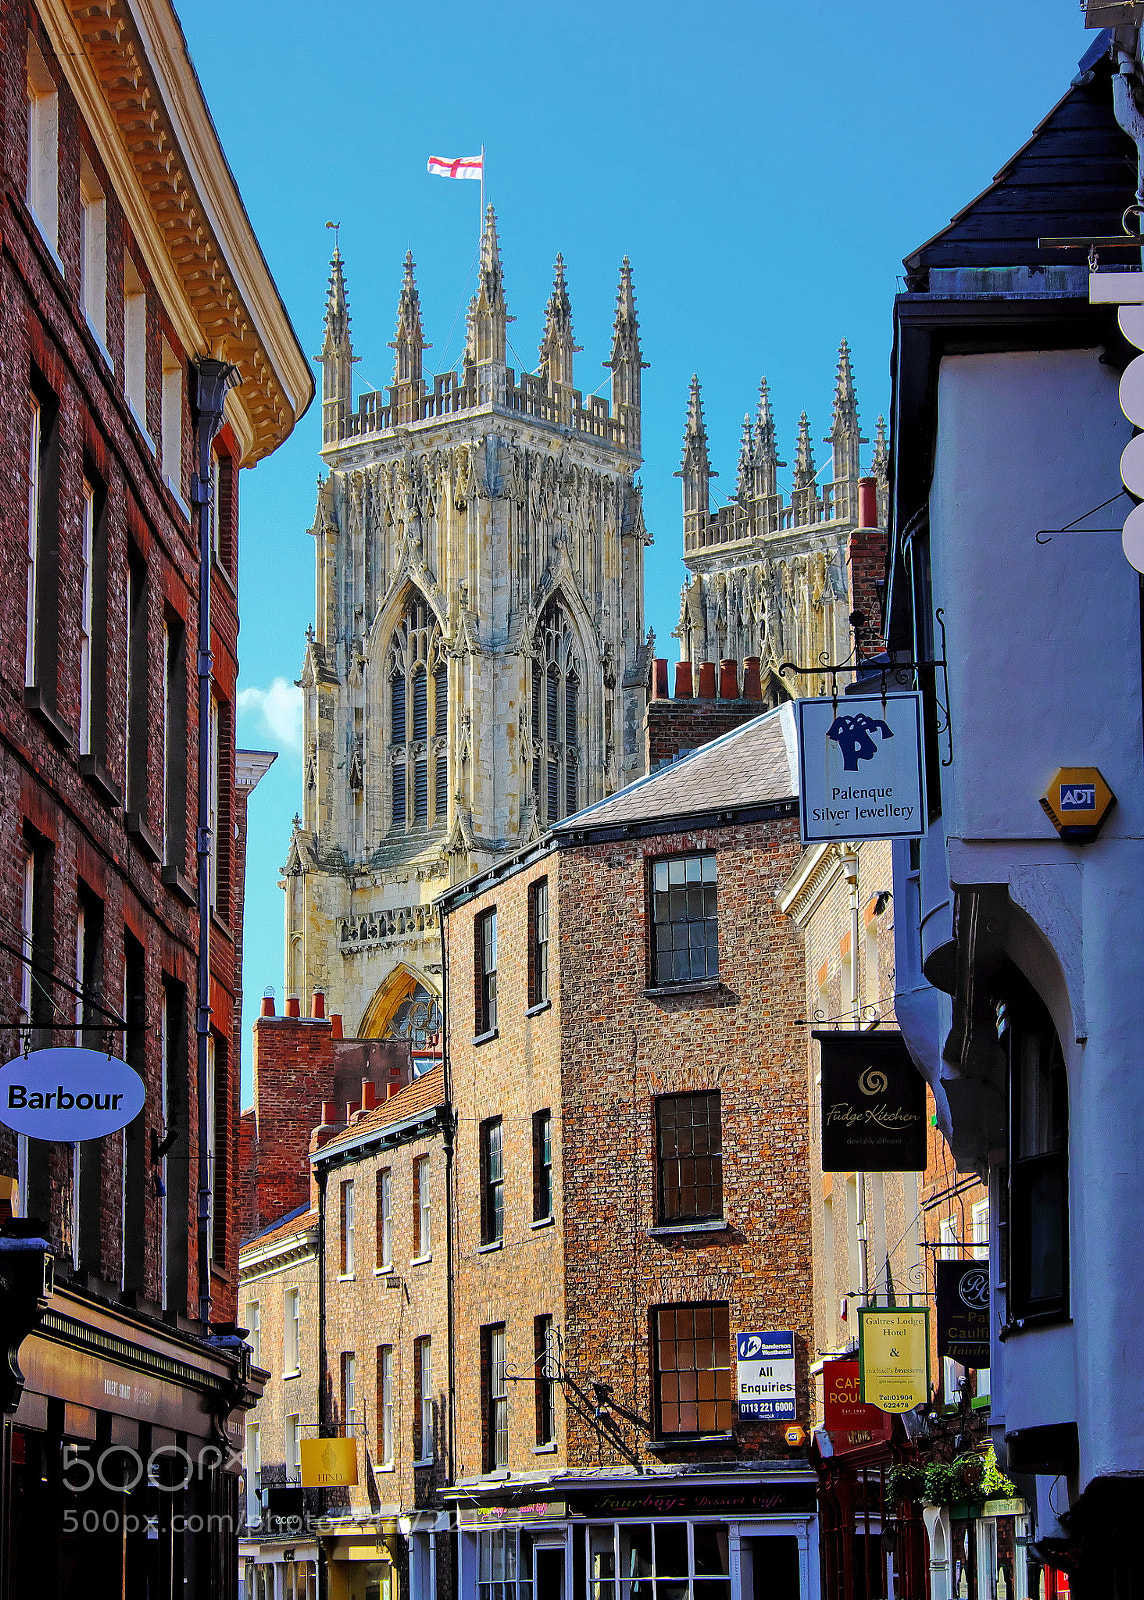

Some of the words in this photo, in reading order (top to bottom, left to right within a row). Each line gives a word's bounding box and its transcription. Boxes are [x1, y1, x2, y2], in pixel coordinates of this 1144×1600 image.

[831, 786, 893, 802] Palenque
[1061, 789, 1095, 804] ADT
[812, 807, 850, 821] Silver
[855, 804, 914, 821] Jewellery
[7, 1084, 124, 1110] Barbour
[826, 1102, 865, 1127] Fudge
[865, 1103, 921, 1130] Kitchen
[865, 1317, 895, 1325] Galtres
[897, 1317, 923, 1326] Lodge
[967, 1312, 990, 1323] Pa
[889, 1347, 900, 1358] &
[758, 1366, 773, 1377] All
[894, 1366, 924, 1374] brasserie
[741, 1381, 793, 1395] Enquiries
[829, 1392, 861, 1404] ROU
[741, 1403, 759, 1413] 0113
[759, 1402, 773, 1412] 221
[775, 1402, 793, 1412] 6000
[318, 1473, 343, 1482] HIND
[275, 1516, 299, 1525] ecco
